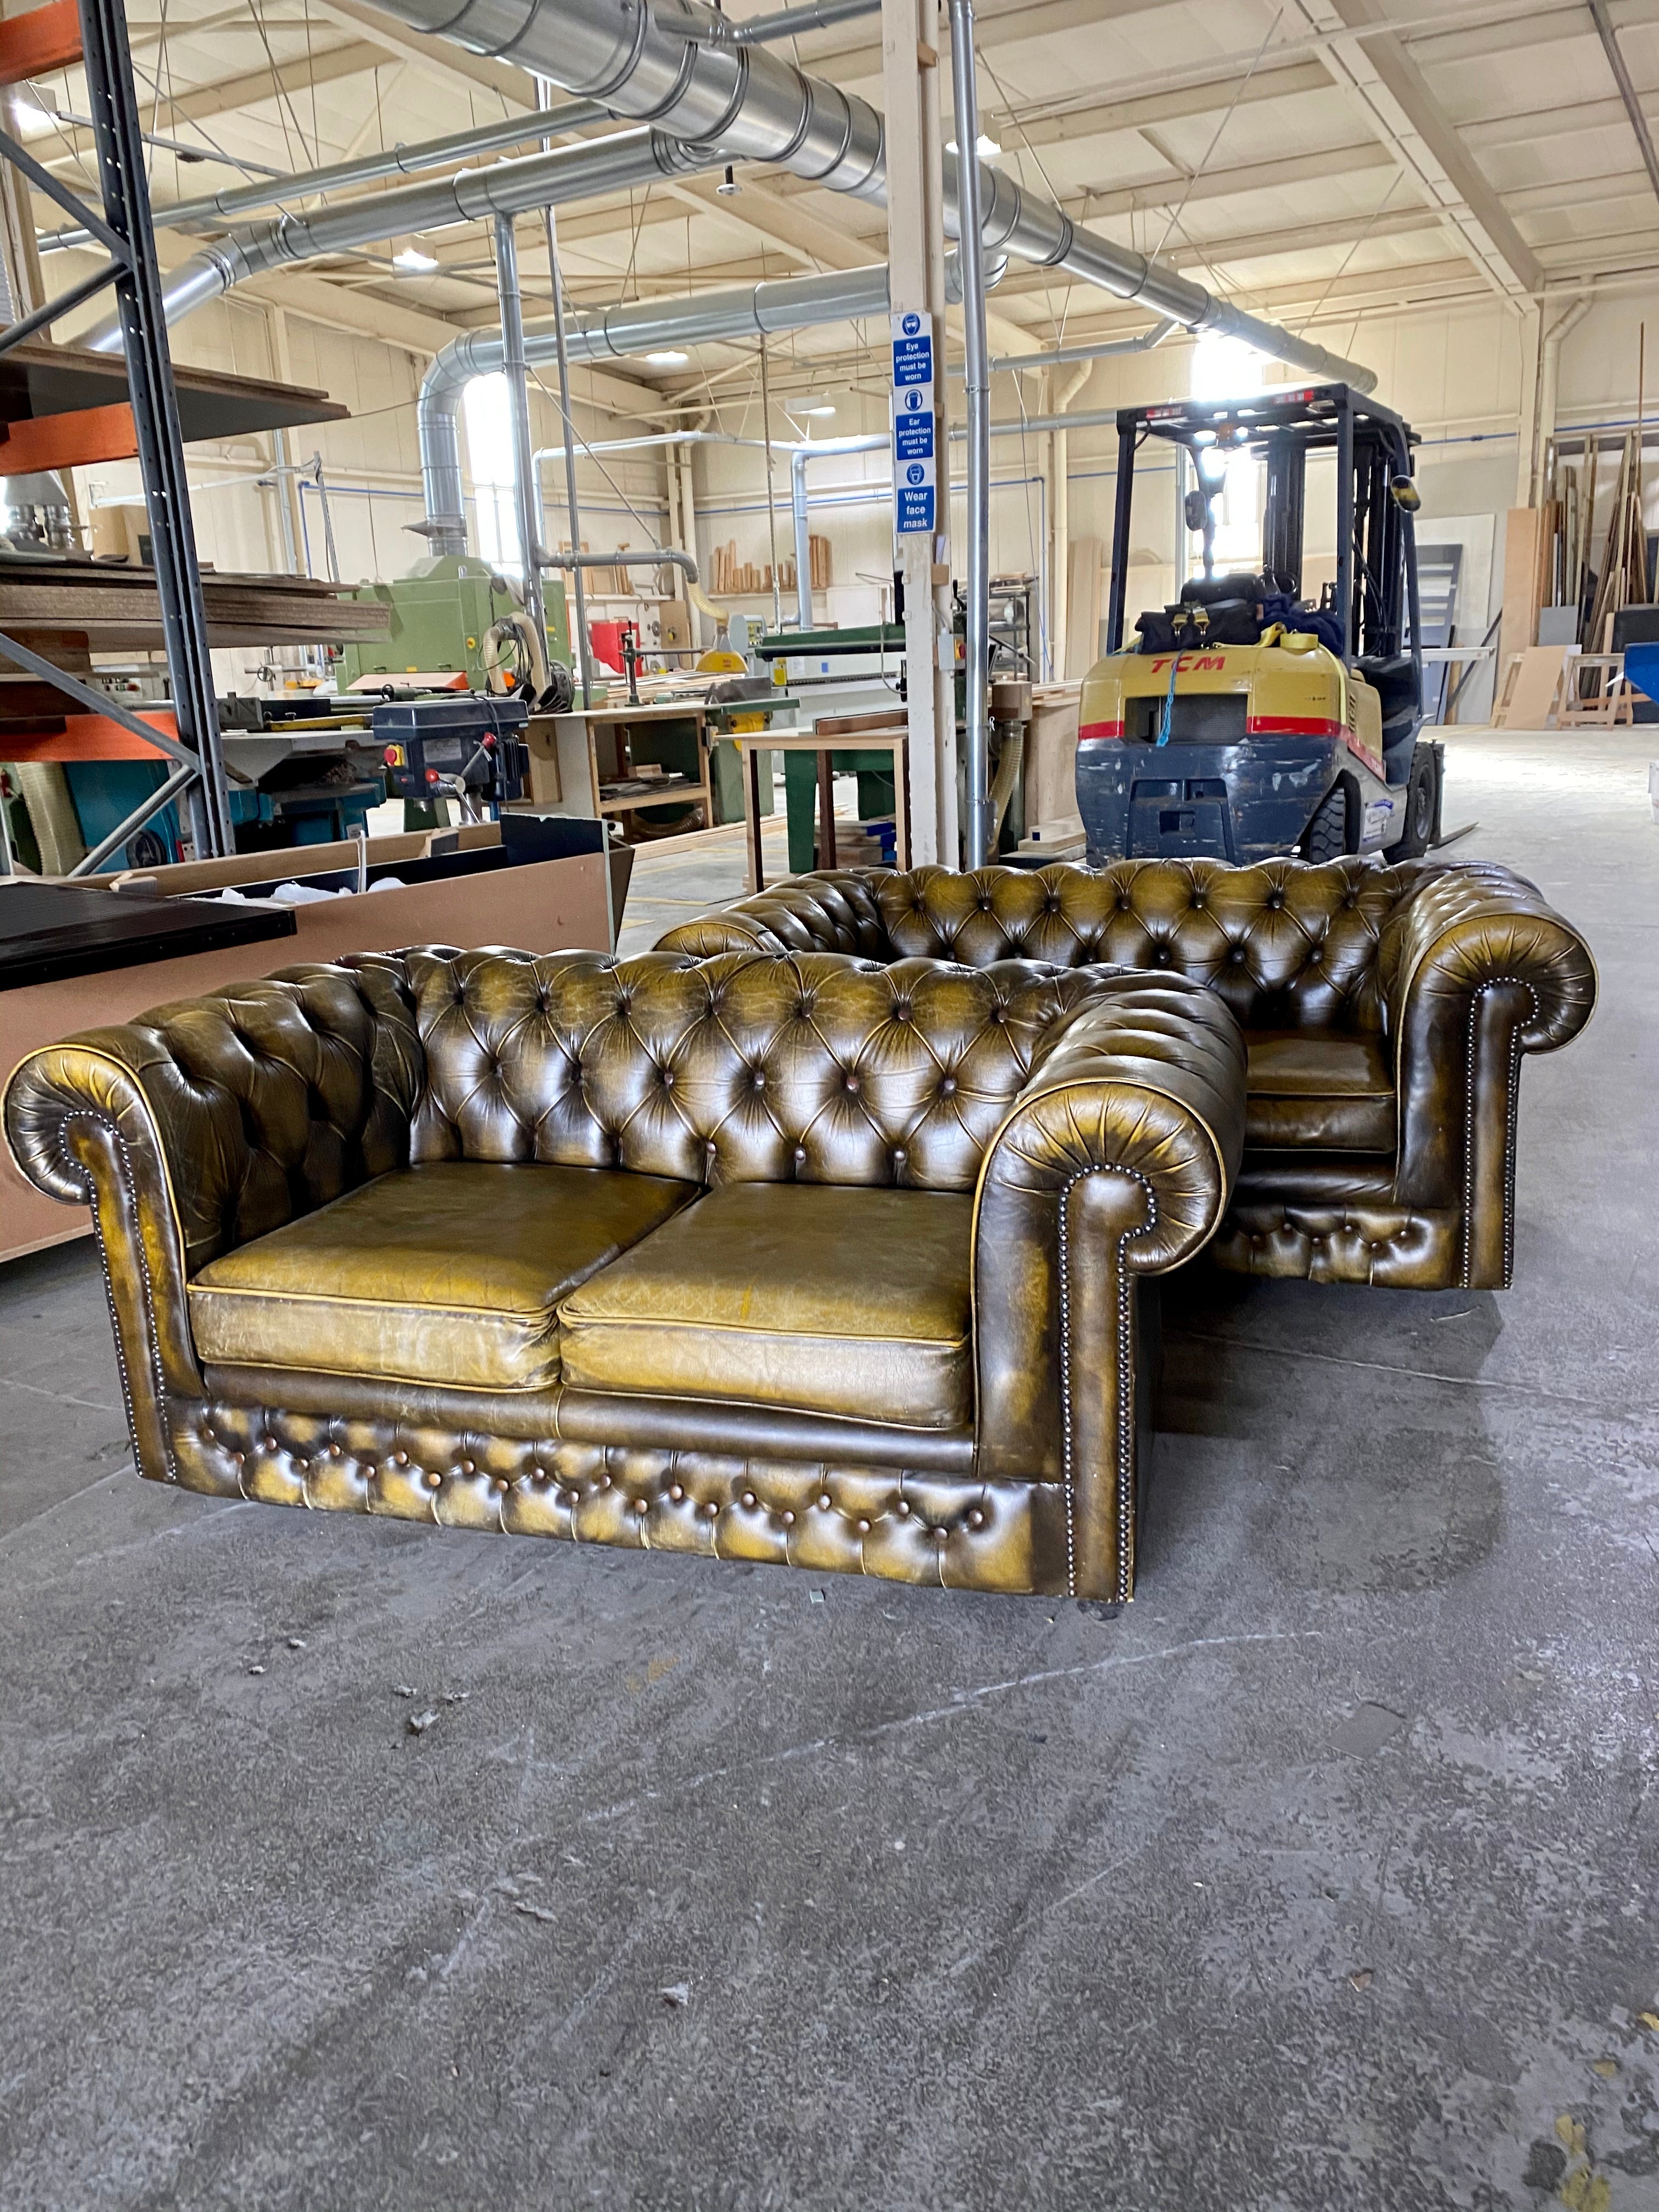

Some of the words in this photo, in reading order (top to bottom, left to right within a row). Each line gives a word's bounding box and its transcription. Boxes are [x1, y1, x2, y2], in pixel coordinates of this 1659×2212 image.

[906, 343, 918, 351] Eye
[896, 352, 929, 363] protection
[900, 363, 916, 371] must
[899, 427, 931, 438] protection
[902, 438, 918, 446] must
[905, 491, 928, 501] Wear
[906, 505, 925, 515] face
[904, 518, 927, 528] mask
[1152, 656, 1226, 673] TCM
